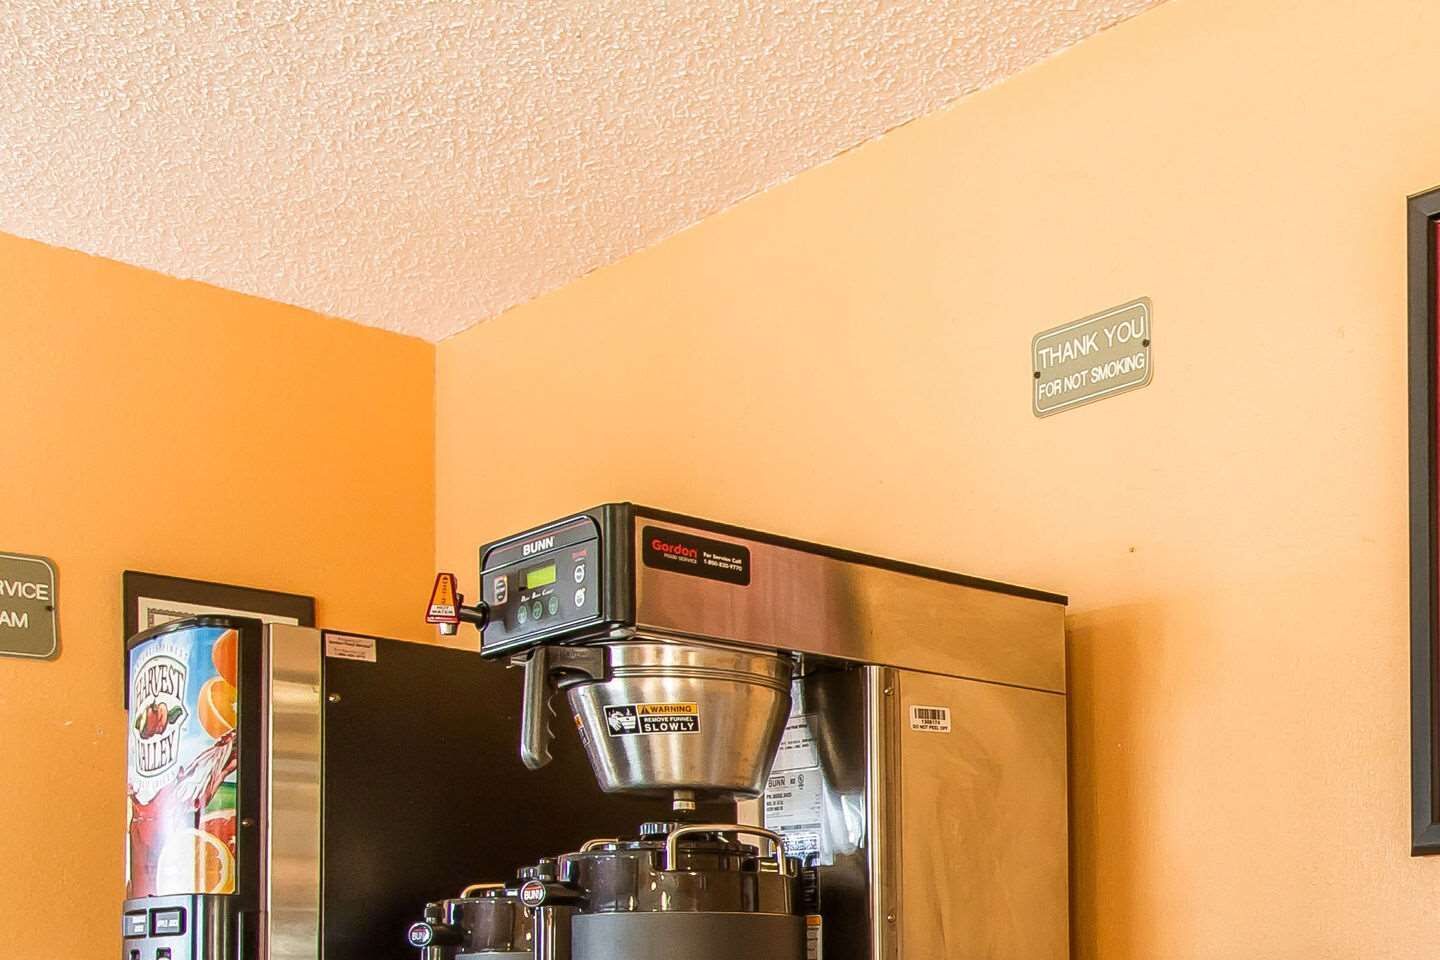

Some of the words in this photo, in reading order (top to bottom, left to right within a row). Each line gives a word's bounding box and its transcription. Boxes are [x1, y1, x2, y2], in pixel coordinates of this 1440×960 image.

[1038, 331, 1100, 370] THANK
[1103, 315, 1145, 348] YOU
[1038, 379, 1062, 401] FOR
[1063, 369, 1089, 393] NOT
[1090, 352, 1145, 384] SMOKING
[522, 536, 555, 557] BUNN
[651, 538, 698, 559] Gordon
[135, 663, 185, 708] HARVEST
[650, 705, 692, 713] WARNING
[643, 722, 695, 732] SLOWLY
[137, 730, 176, 773] VALLEY
